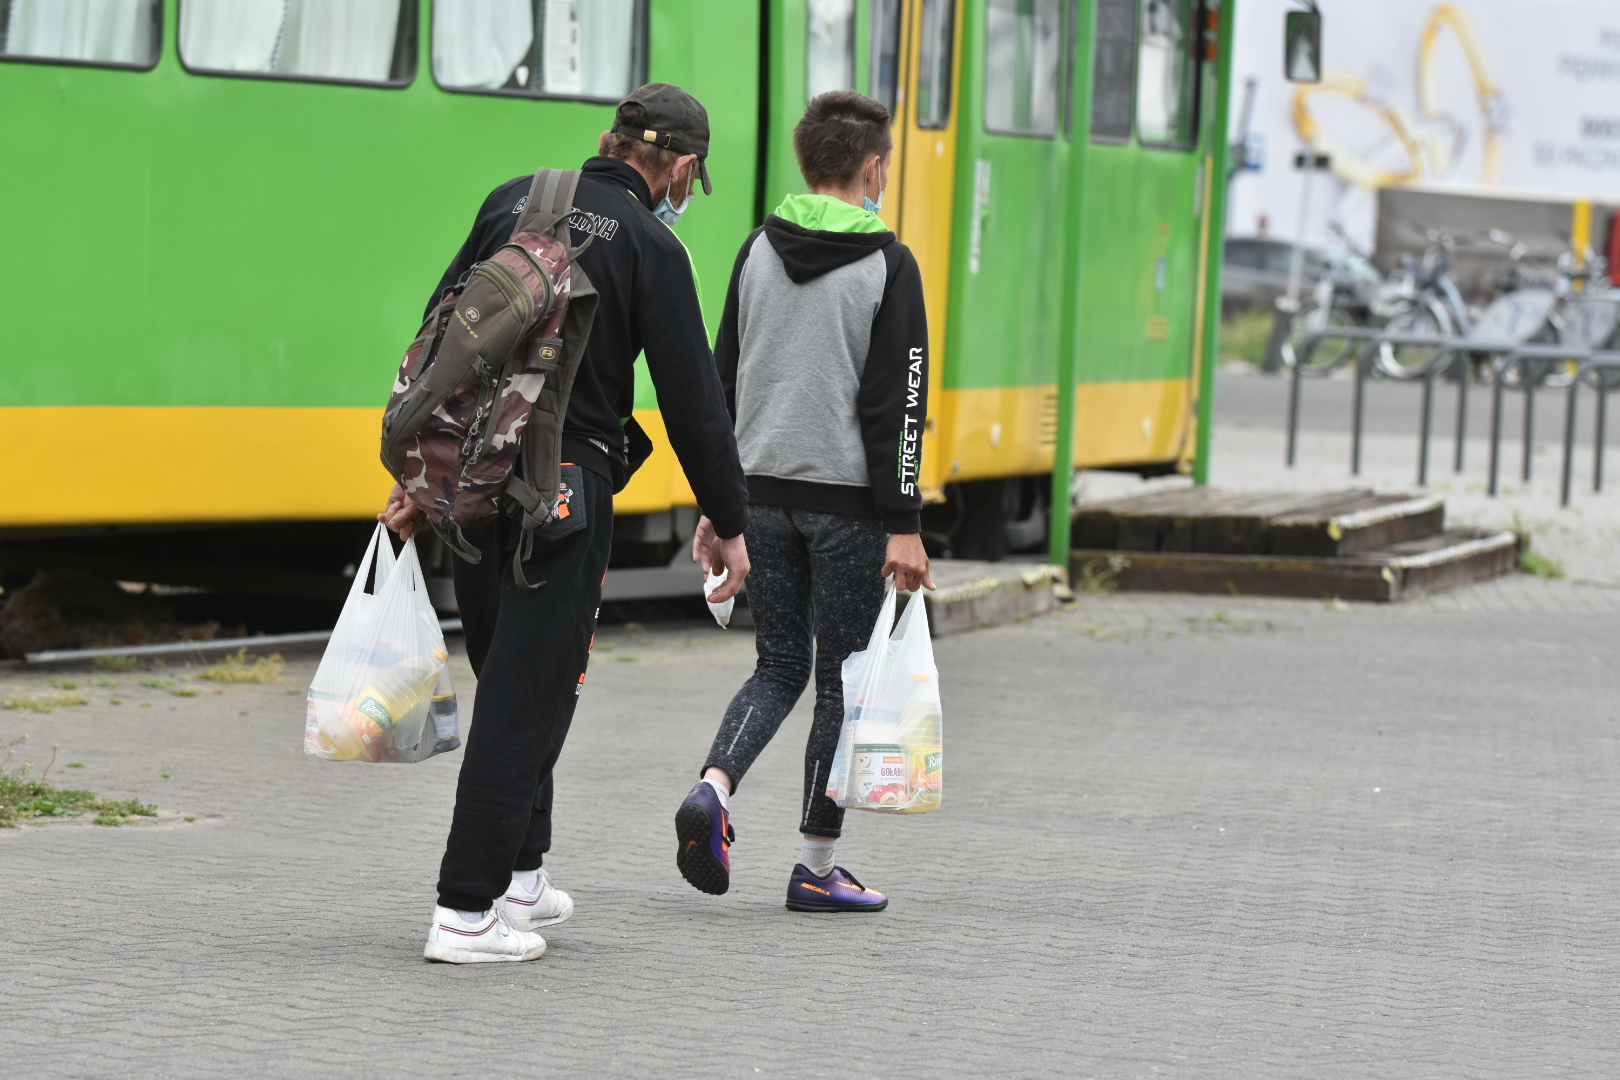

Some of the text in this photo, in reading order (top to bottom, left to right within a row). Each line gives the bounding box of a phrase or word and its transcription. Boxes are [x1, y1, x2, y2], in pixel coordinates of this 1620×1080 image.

[512, 195, 619, 241] BLONA
[900, 347, 923, 497] STREET WEAR
